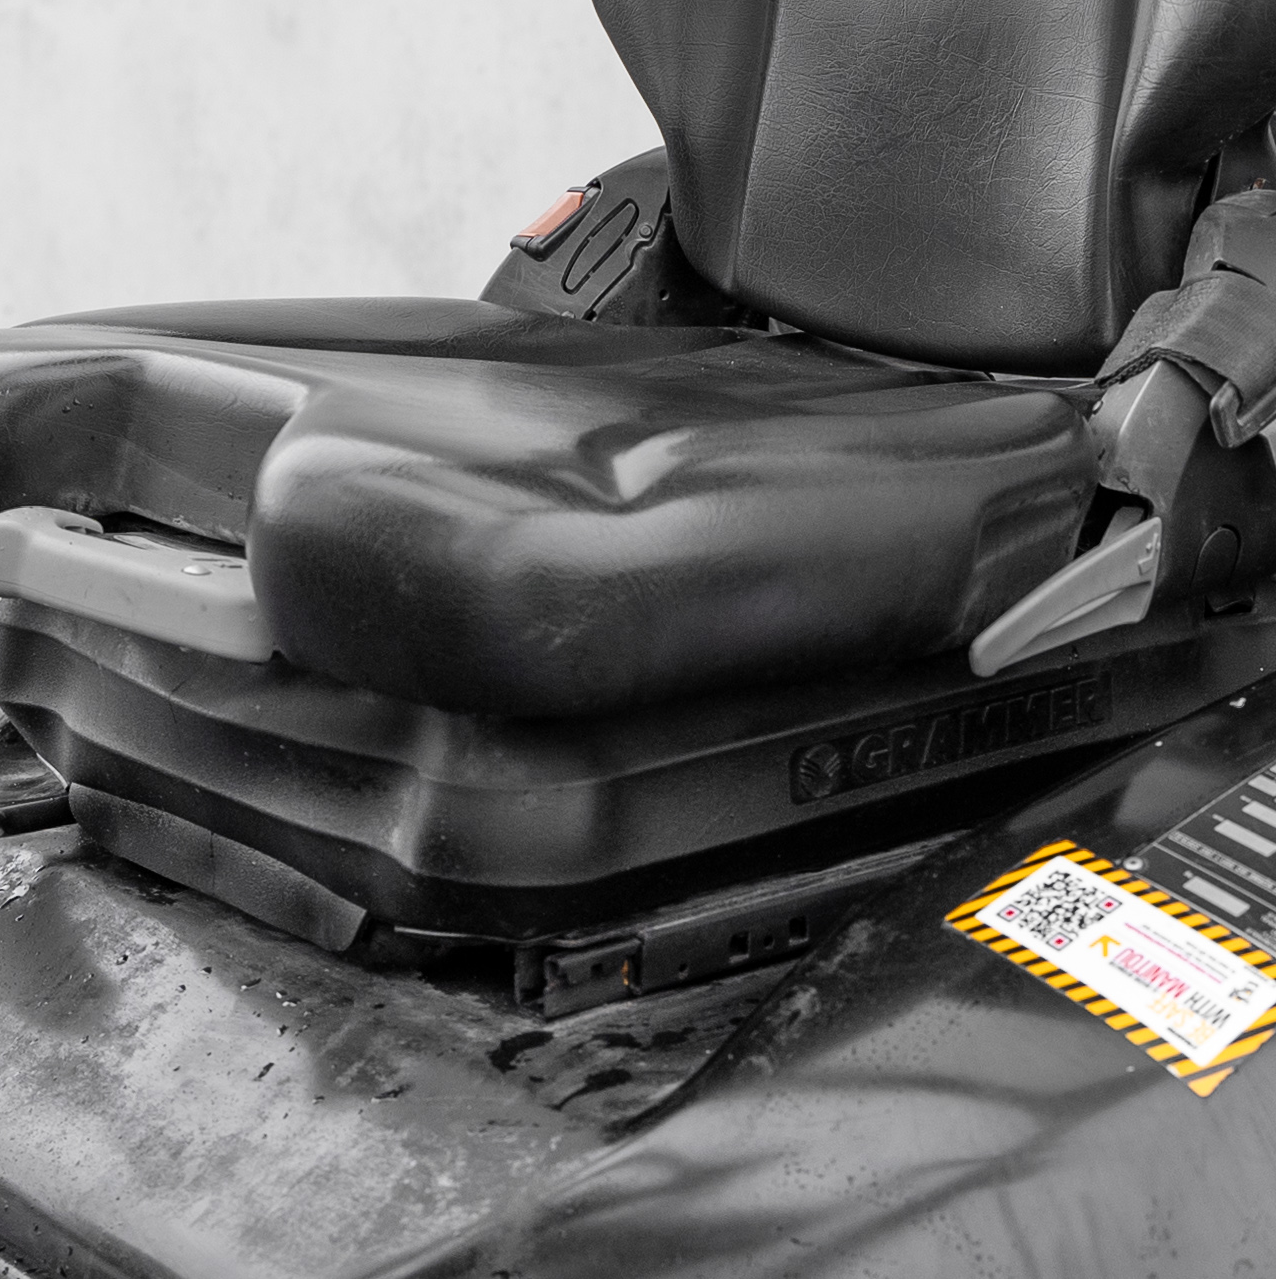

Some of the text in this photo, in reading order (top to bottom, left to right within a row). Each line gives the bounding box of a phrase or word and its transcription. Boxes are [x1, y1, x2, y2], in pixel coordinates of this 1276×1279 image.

[851, 677, 1106, 783] GRAMMER
[1113, 948, 1191, 999] MANITOU
[1147, 992, 1195, 1029] SAFE
[1184, 991, 1231, 1029] WITH
[1188, 1019, 1217, 1046] BE
